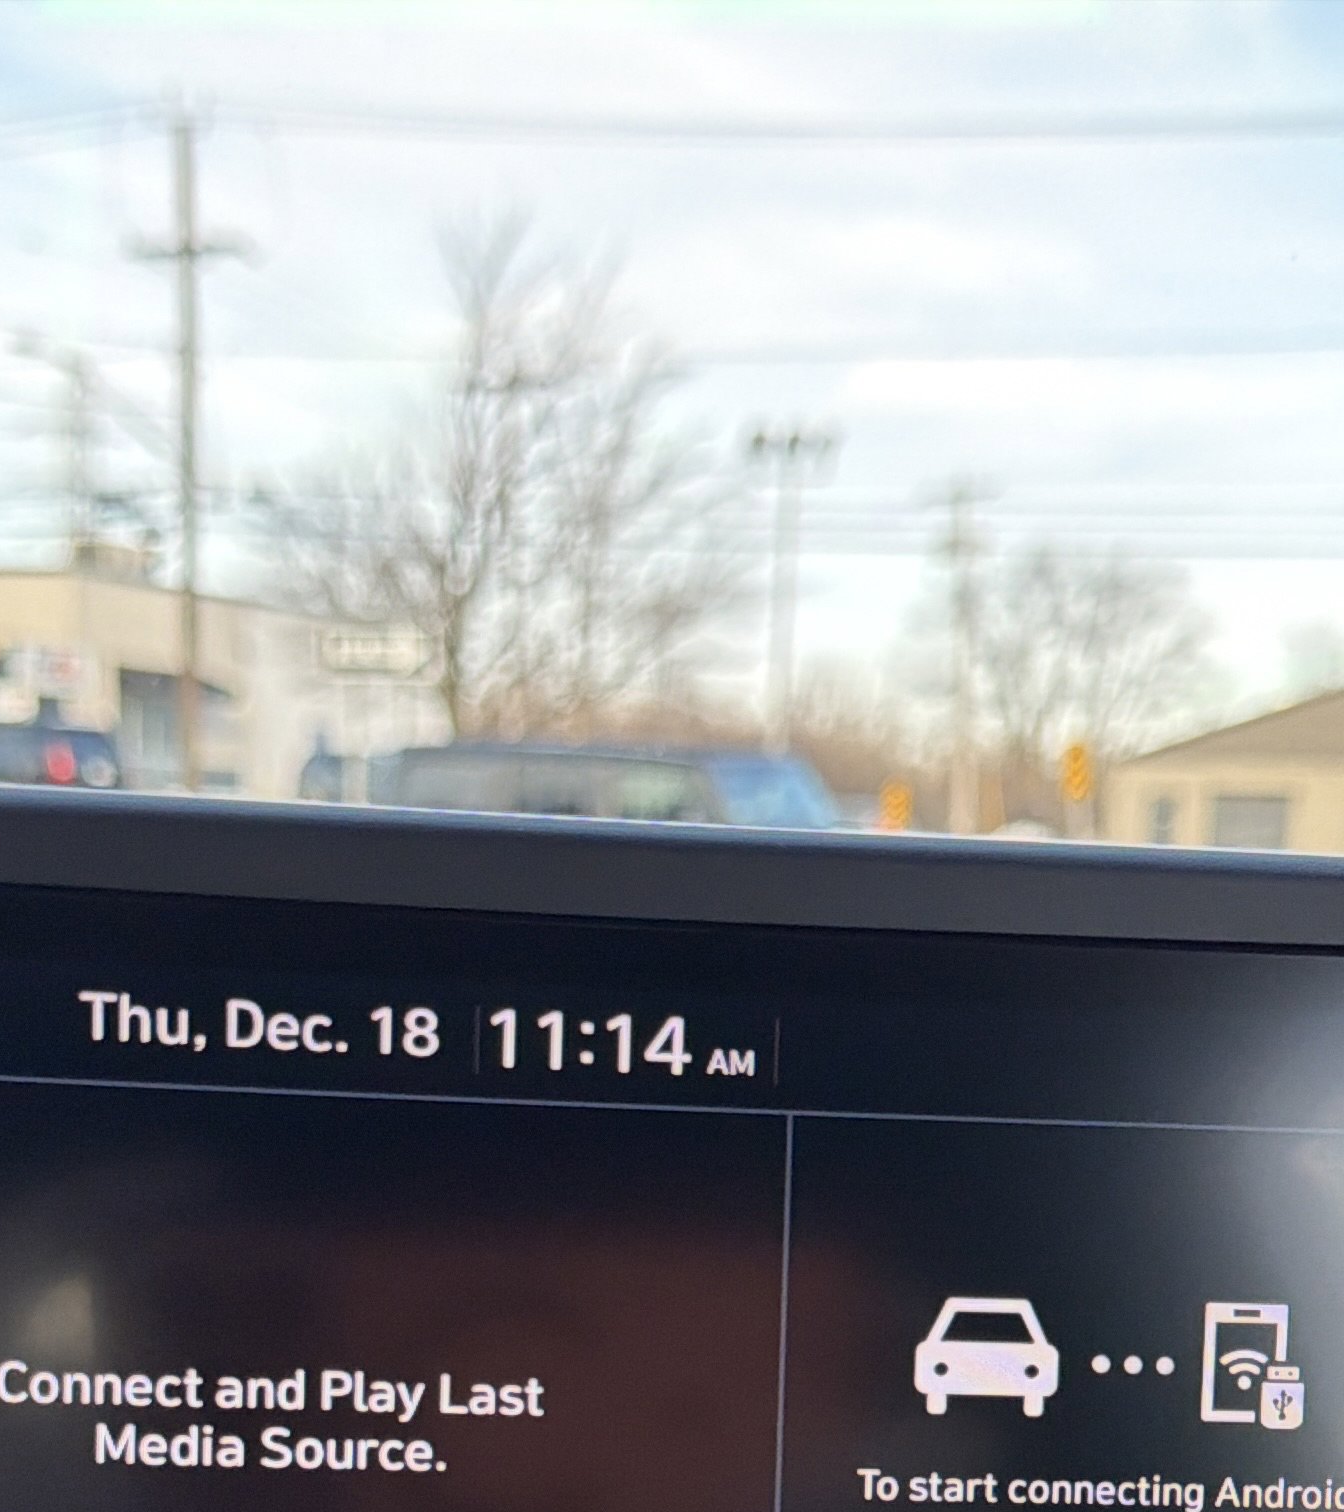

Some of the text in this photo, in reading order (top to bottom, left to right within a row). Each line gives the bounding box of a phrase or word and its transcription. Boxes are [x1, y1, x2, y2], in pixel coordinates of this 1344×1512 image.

[78, 990, 756, 1077] Thu, Dec. 18 11:14 AM
[214, 1368, 306, 1411] and
[320, 1369, 426, 1423] Play
[439, 1373, 545, 1417] Last
[95, 1422, 447, 1472] Media Source.
[856, 1468, 900, 1502] To
[908, 1471, 998, 1504] start
